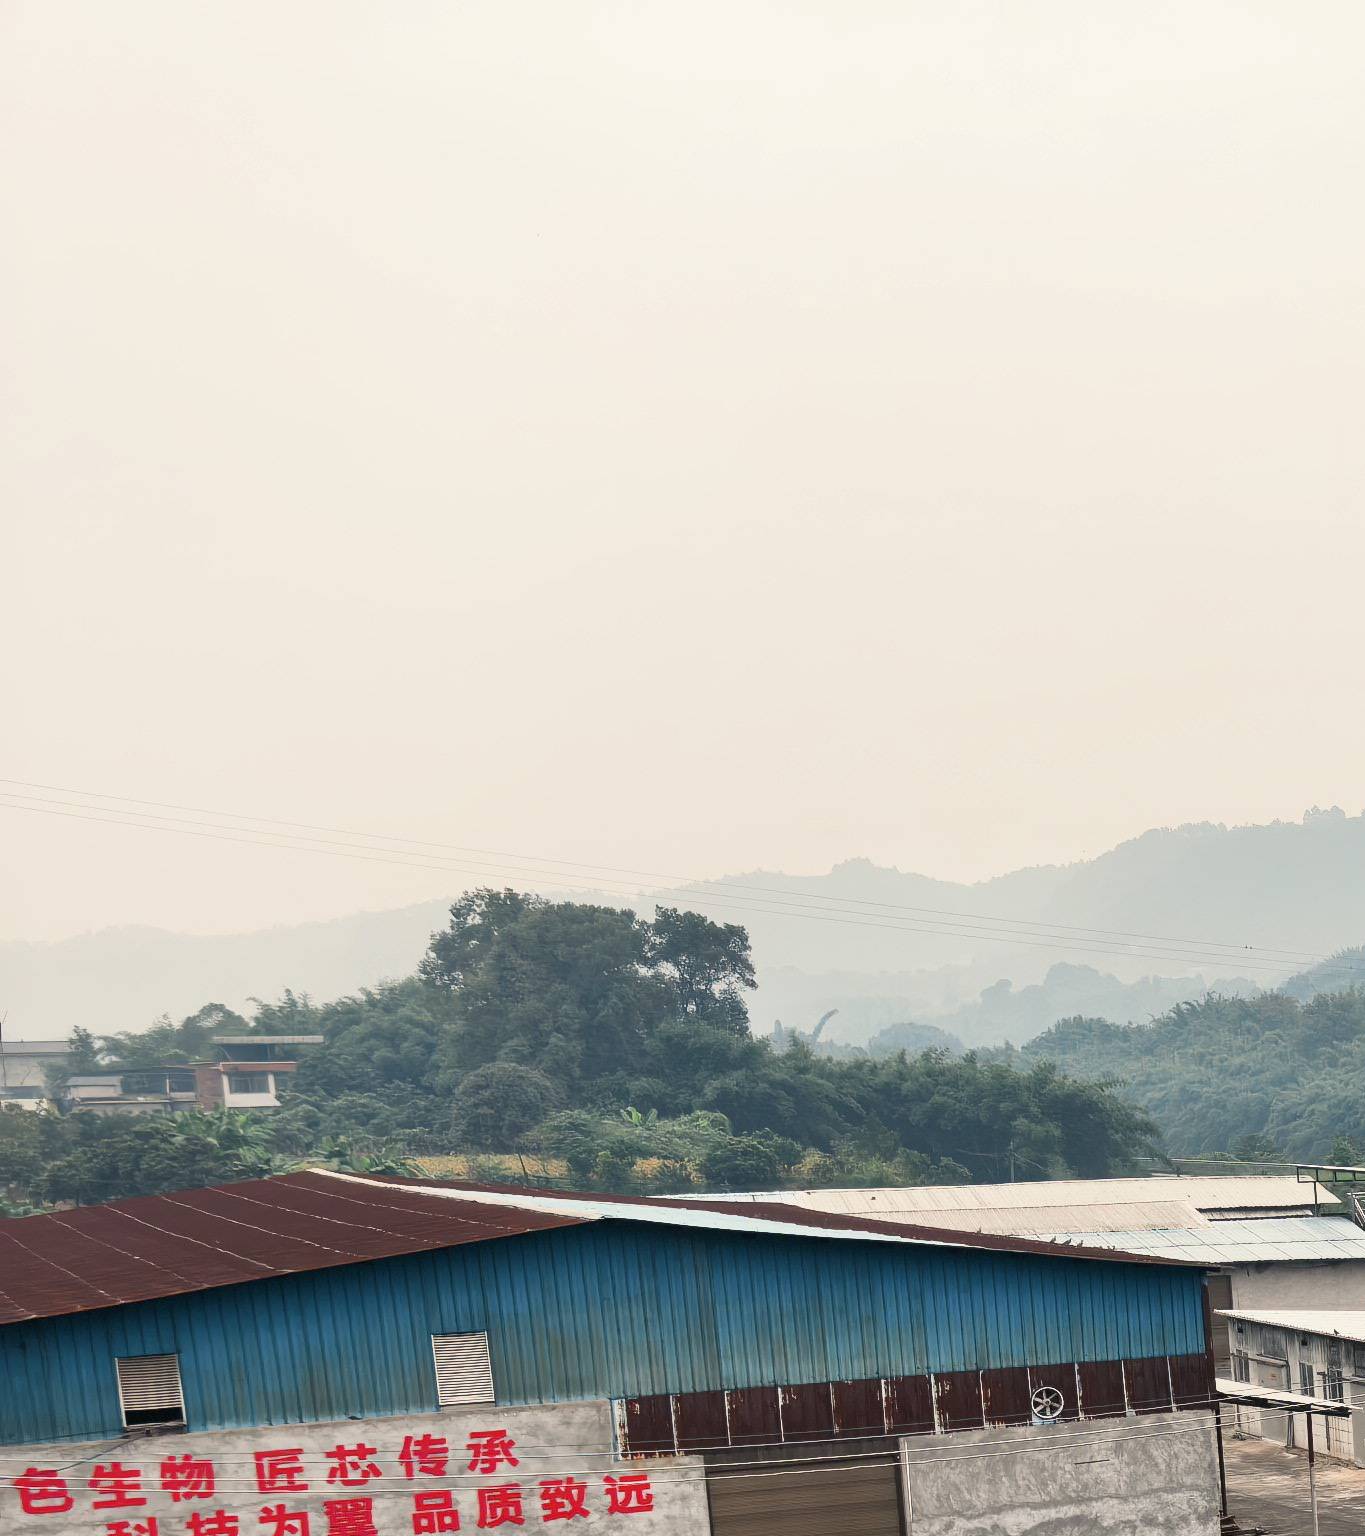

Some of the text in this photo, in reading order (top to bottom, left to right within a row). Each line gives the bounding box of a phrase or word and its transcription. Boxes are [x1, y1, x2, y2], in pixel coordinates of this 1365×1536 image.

[12, 1429, 520, 1516] 色生物 匠芯传承
[411, 1474, 655, 1536] 品质致远
